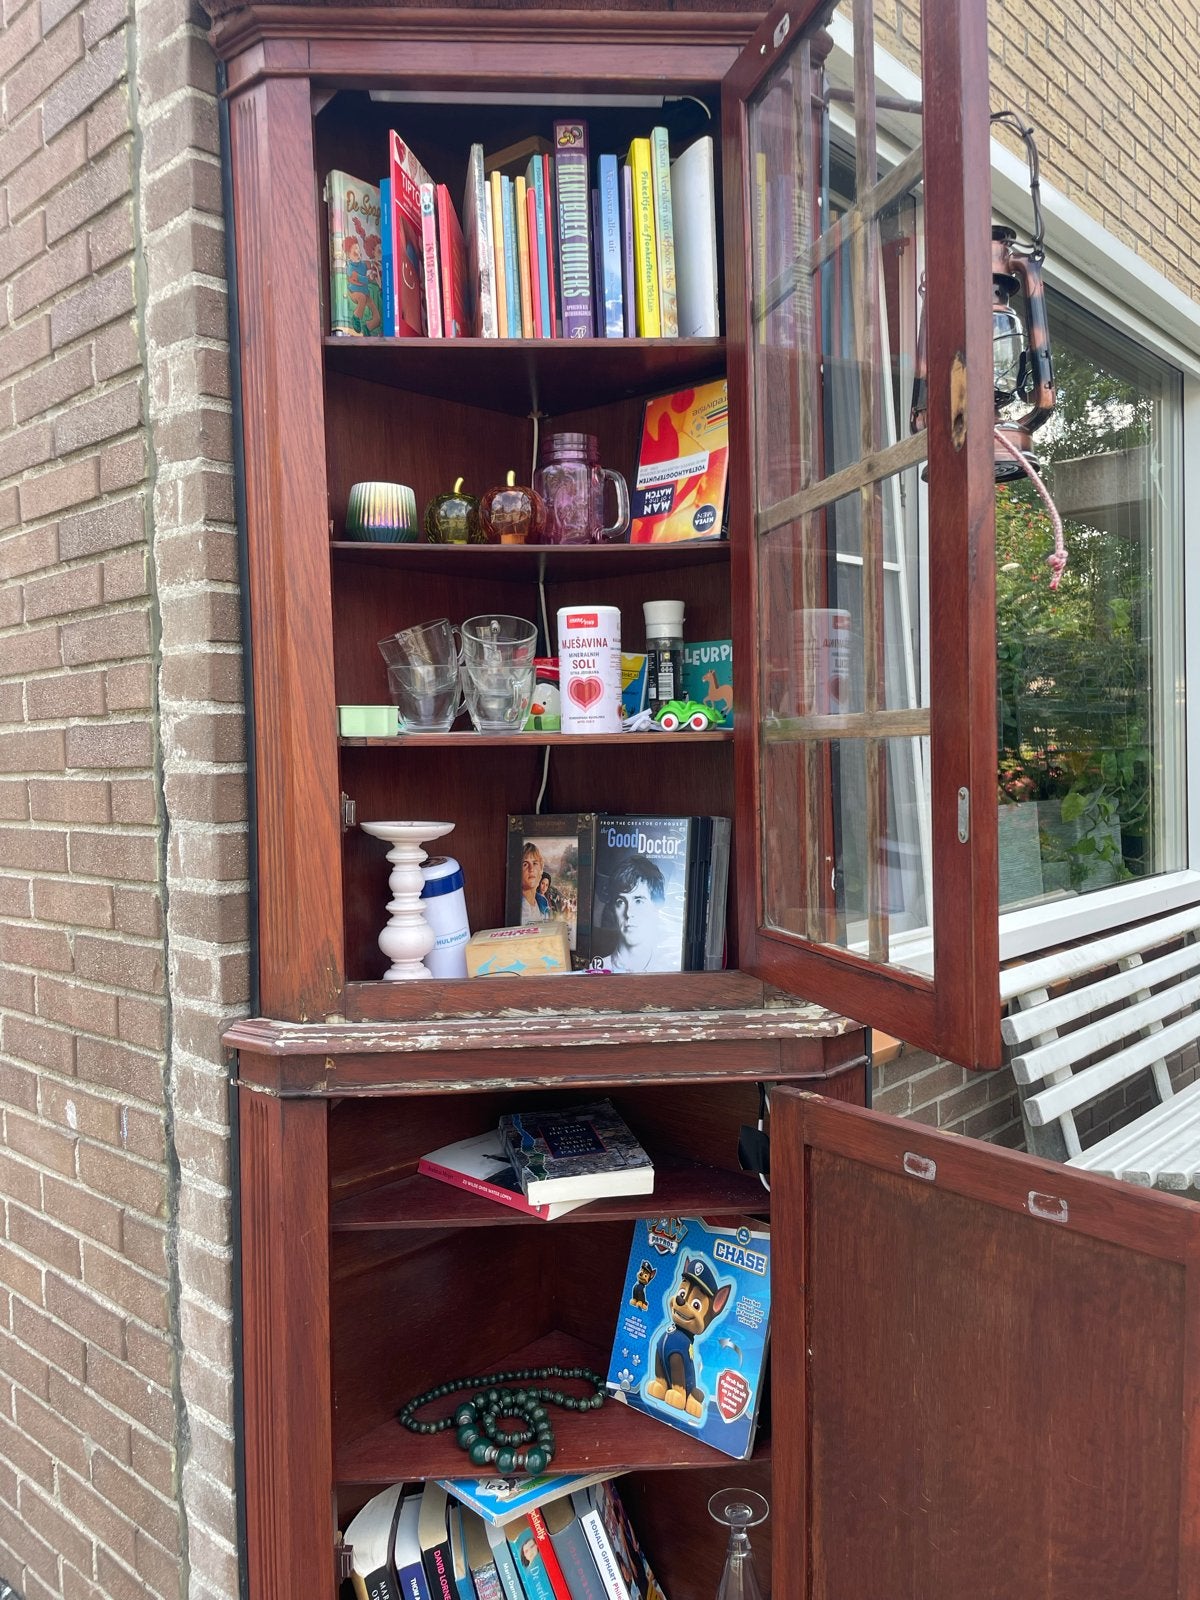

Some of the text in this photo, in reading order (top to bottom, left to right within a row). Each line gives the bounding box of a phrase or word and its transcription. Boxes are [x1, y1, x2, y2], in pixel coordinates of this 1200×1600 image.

[659, 139, 669, 168] Kraan
[639, 171, 650, 211] Pinkeltje
[660, 174, 671, 213] Verhalen
[346, 190, 360, 213] De
[558, 164, 589, 239] HANDBOEK
[607, 217, 617, 237] alles
[662, 214, 671, 231] van
[608, 240, 616, 253] uit
[641, 232, 654, 283] flonkersteen
[561, 242, 591, 298] OUDERS
[665, 267, 674, 288] heks
[638, 464, 706, 485] VOETBALHOOGTEPUNTEN
[644, 487, 672, 500] MATCH
[643, 500, 671, 515] MAN
[697, 511, 714, 520] MEN
[694, 517, 714, 527] NIVEA
[561, 636, 609, 650] MJEŠAVINA
[682, 644, 733, 666] LEURP
[572, 659, 596, 670] SOLI
[607, 828, 638, 848] Good
[637, 833, 682, 854] Doctor
[594, 959, 602, 969] 12
[553, 1137, 594, 1147] VARKEN
[560, 1146, 597, 1155] PALEIS
[499, 1192, 513, 1201] LOPEN
[647, 1217, 689, 1242] PAW
[651, 1235, 674, 1249] PATROL
[715, 1242, 766, 1273] CHASE
[742, 1296, 752, 1305] Lees
[725, 1375, 745, 1390] Druk het
[589, 1519, 605, 1550] RONALD
[601, 1549, 617, 1582] GIPHART
[433, 1549, 446, 1575] DAVID
[502, 1563, 512, 1581] Marie
[530, 1566, 539, 1580] De
[410, 1577, 420, 1596] THOM
